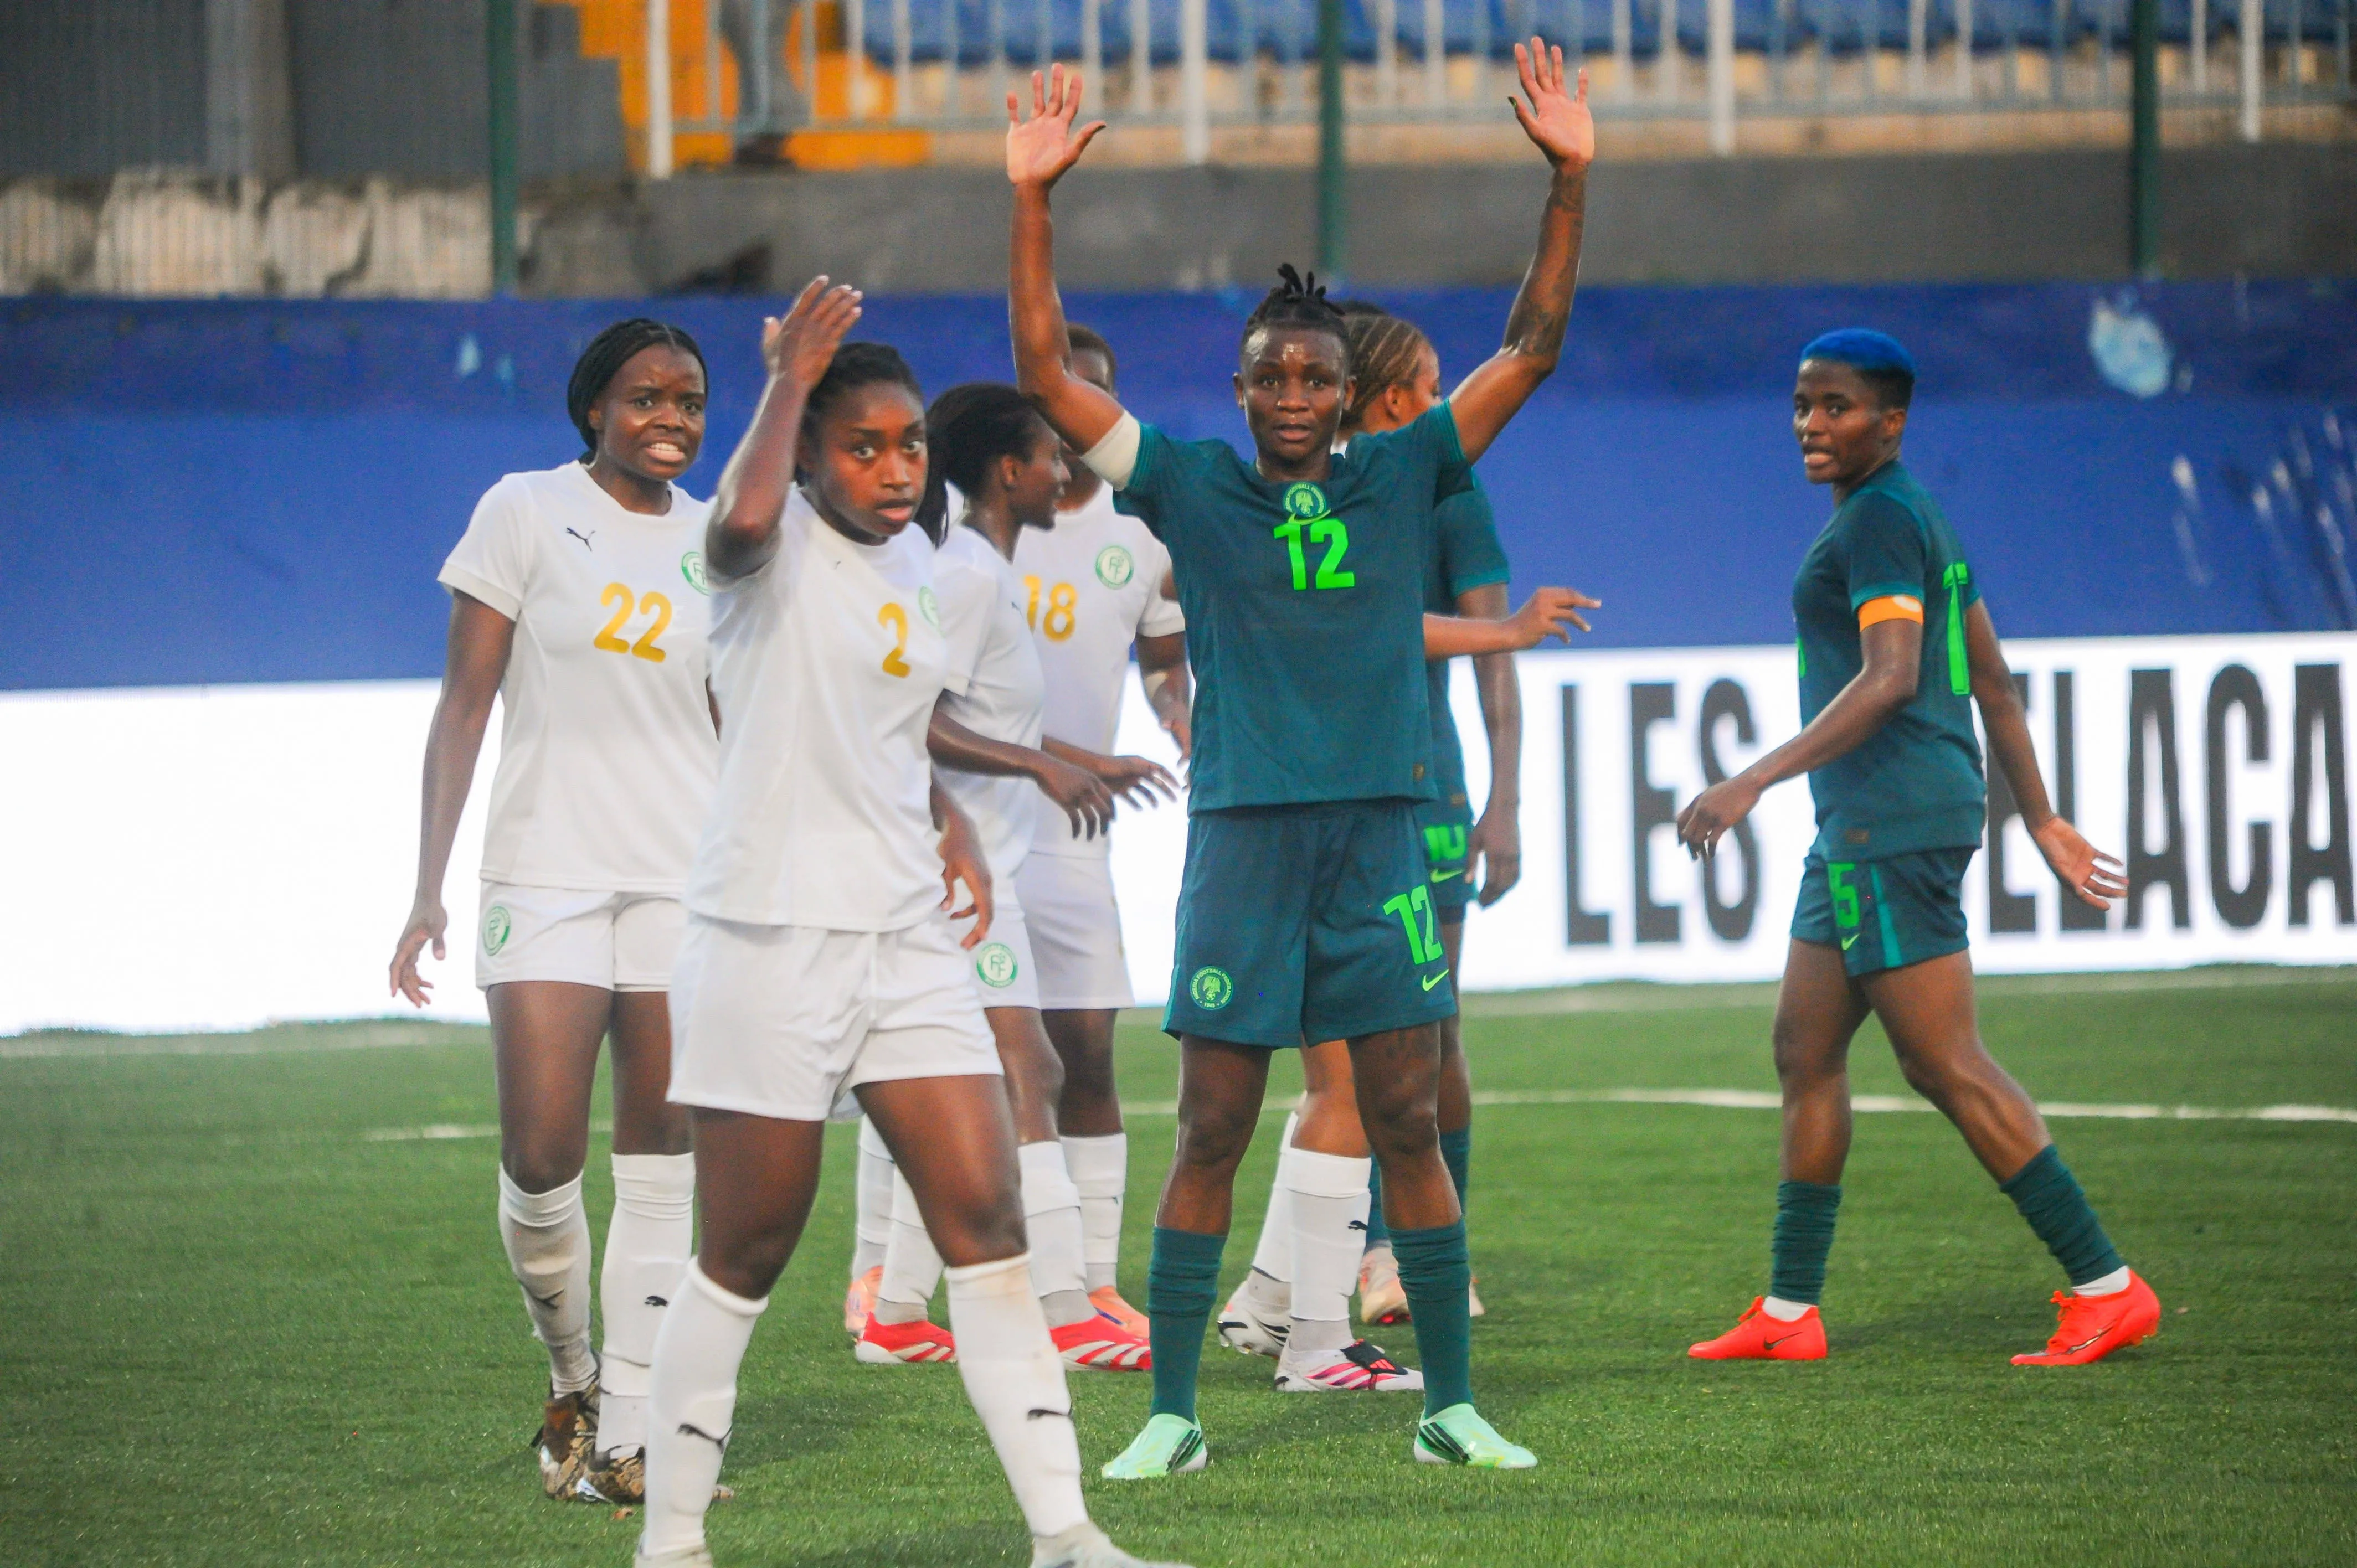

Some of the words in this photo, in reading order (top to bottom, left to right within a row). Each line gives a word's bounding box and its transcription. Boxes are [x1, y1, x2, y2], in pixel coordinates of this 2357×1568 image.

[1274, 518, 1355, 591] 12
[594, 582, 672, 663] 22
[878, 603, 911, 678] 2
[1023, 574, 1078, 642] 18
[1561, 678, 1760, 945] LES
[1383, 885, 1443, 965] 12
[1196, 968, 1221, 979] FOOTBALL
